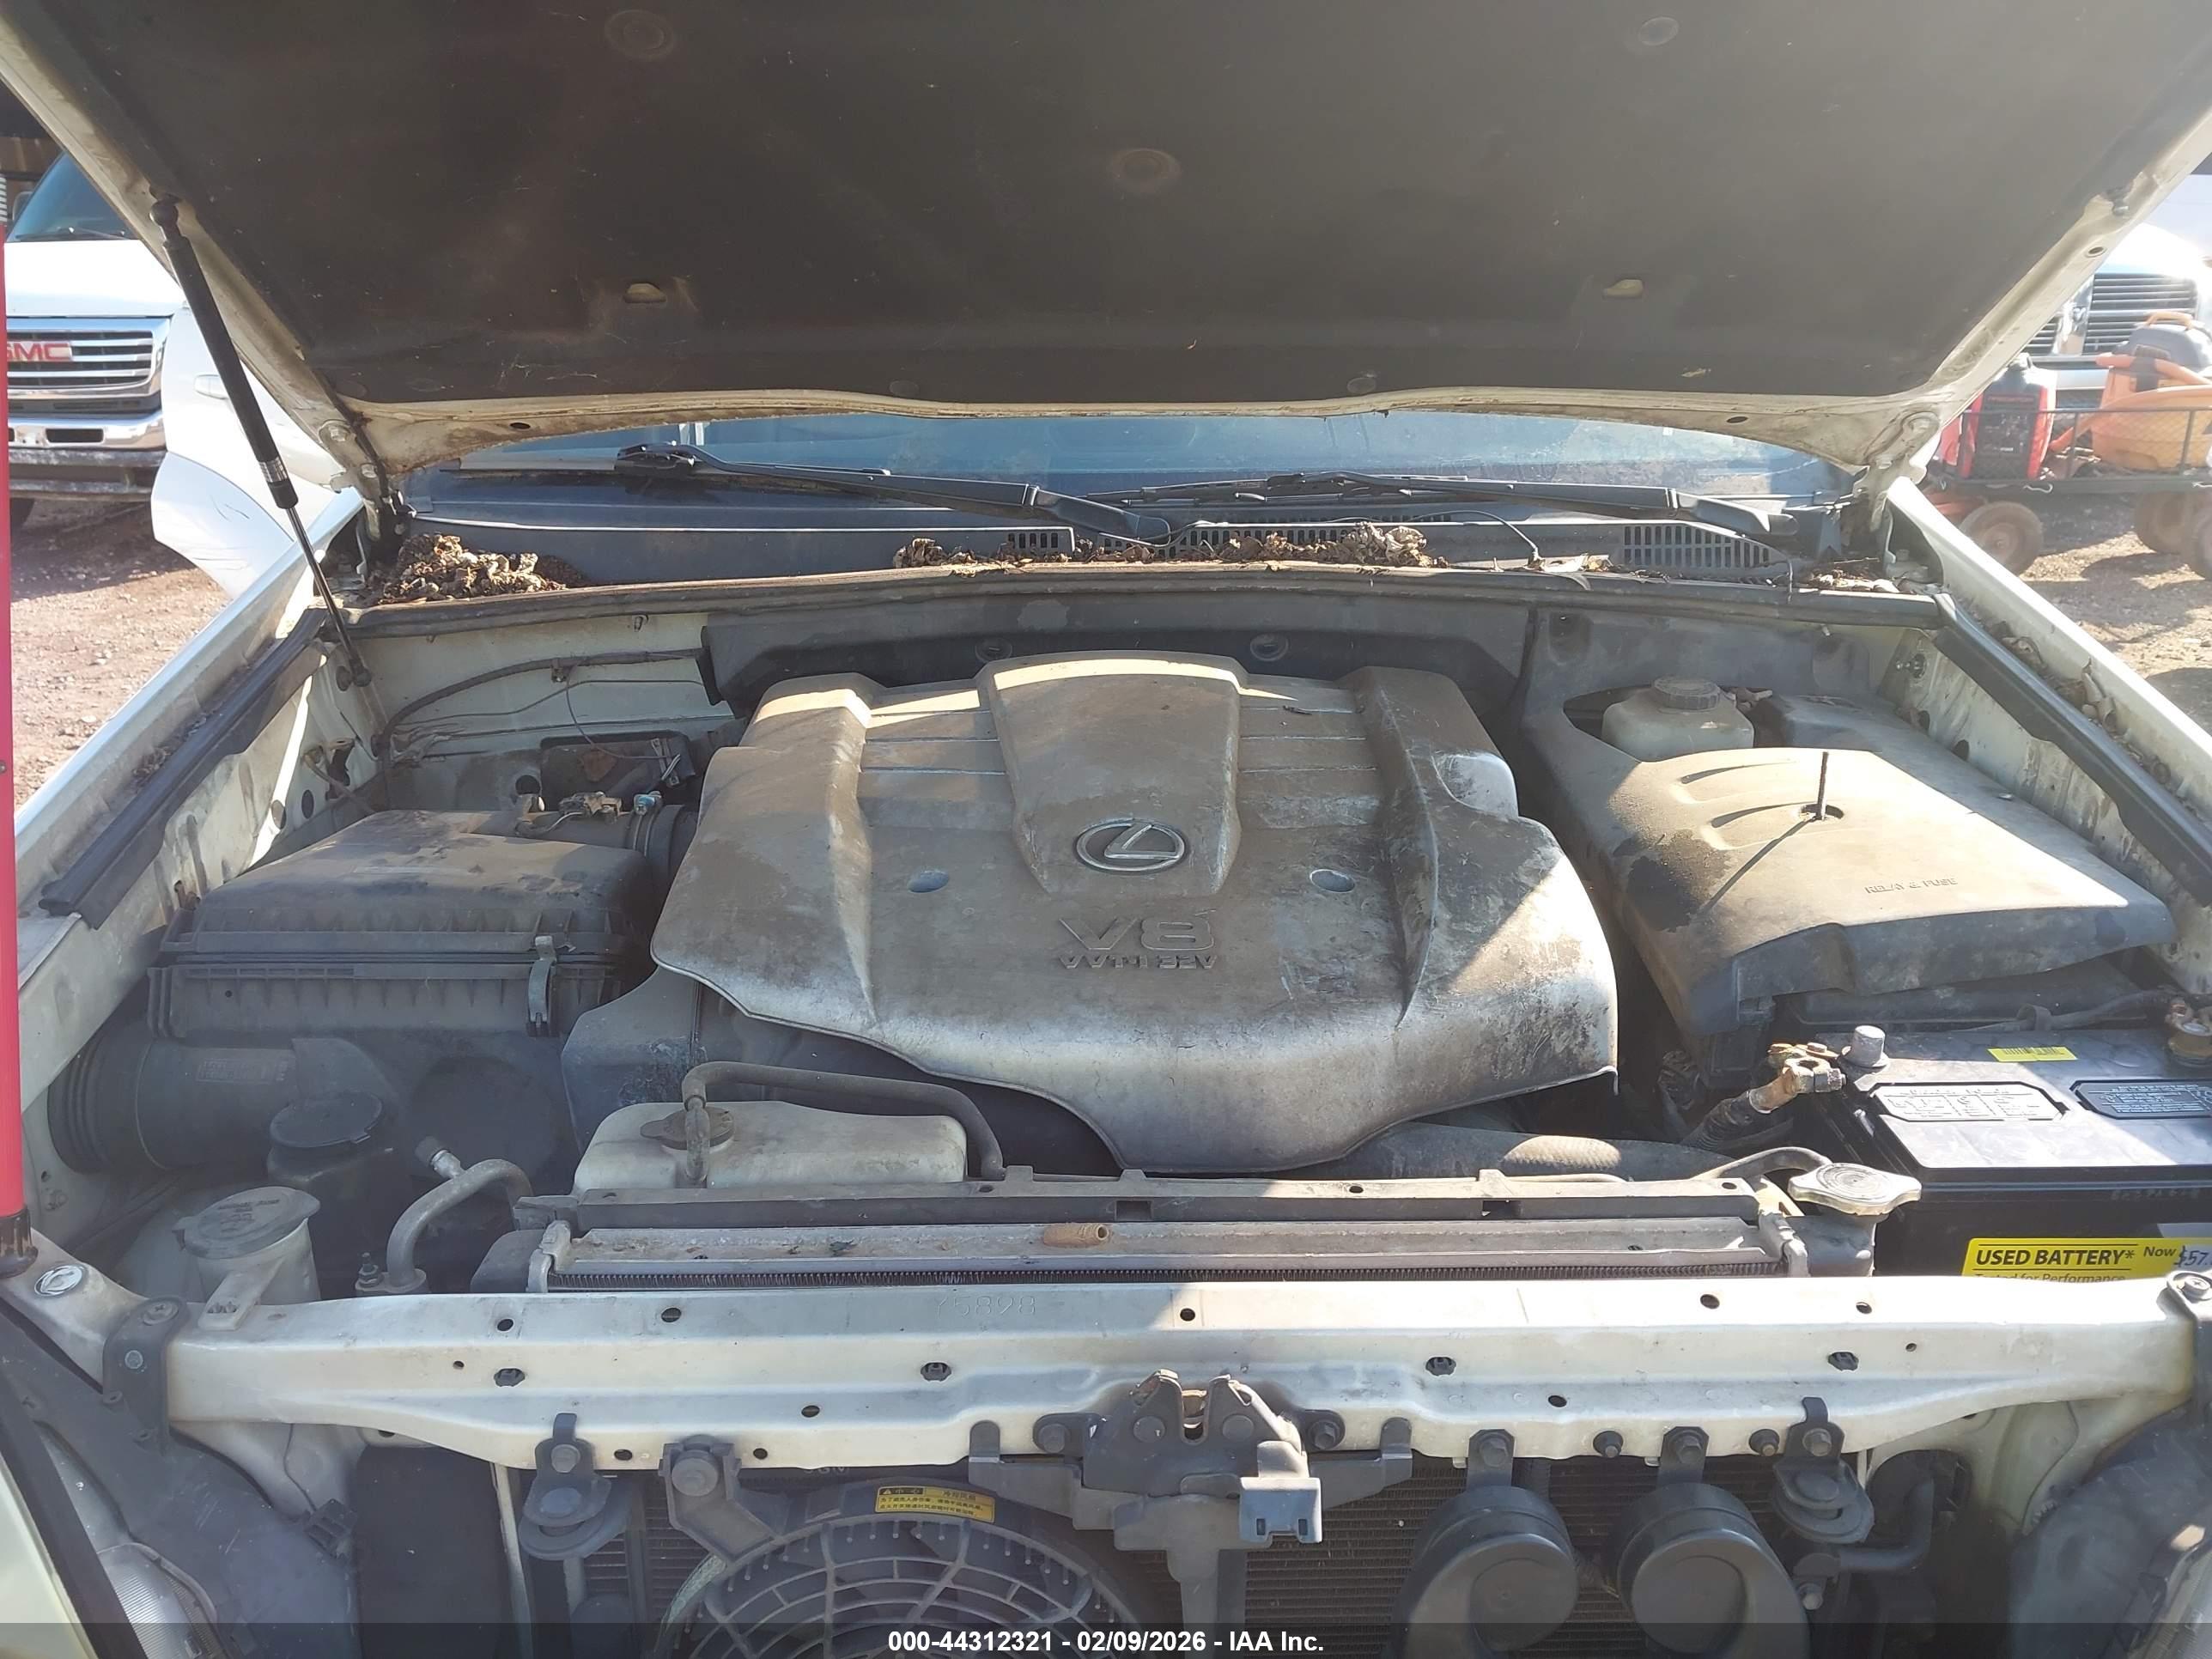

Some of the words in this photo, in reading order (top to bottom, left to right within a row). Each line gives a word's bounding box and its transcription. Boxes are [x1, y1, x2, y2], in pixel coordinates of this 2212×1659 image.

[1864, 879, 1905, 894] RELAY
[1923, 878, 1958, 888] FUSE
[1058, 917, 1215, 951] V8
[1158, 954, 1217, 969] 32V
[1976, 1249, 2031, 1266] USED
[2143, 1246, 2178, 1258] Now
